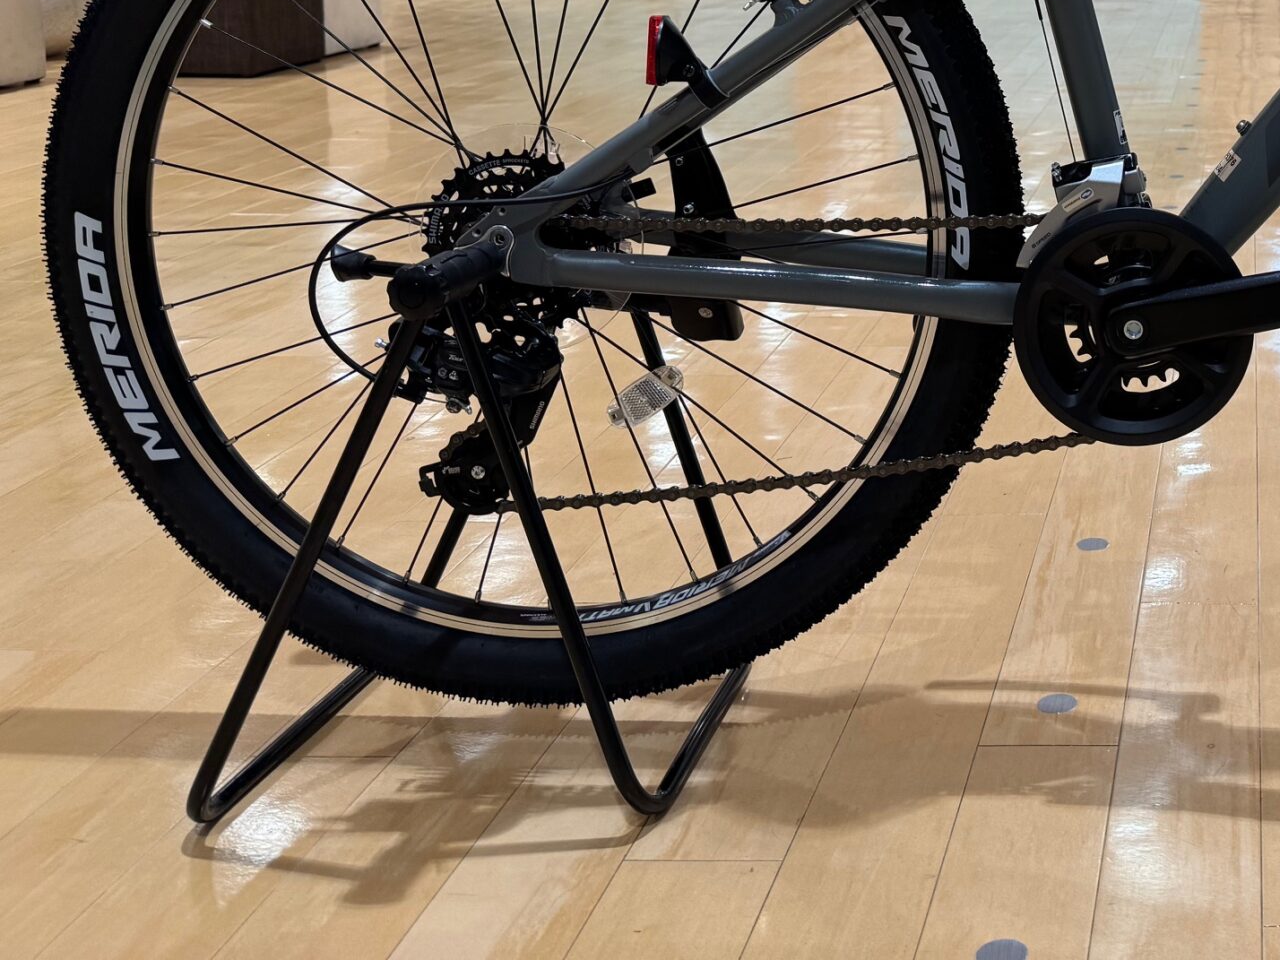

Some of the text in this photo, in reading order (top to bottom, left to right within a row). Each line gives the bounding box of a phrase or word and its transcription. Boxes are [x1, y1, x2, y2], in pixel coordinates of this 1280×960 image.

[468, 160, 501, 176] CASSETTE
[883, 15, 970, 271] MERIDA
[429, 193, 449, 244] SHIMAO
[74, 211, 181, 461] MERIDA
[653, 558, 750, 610] MERIDA
